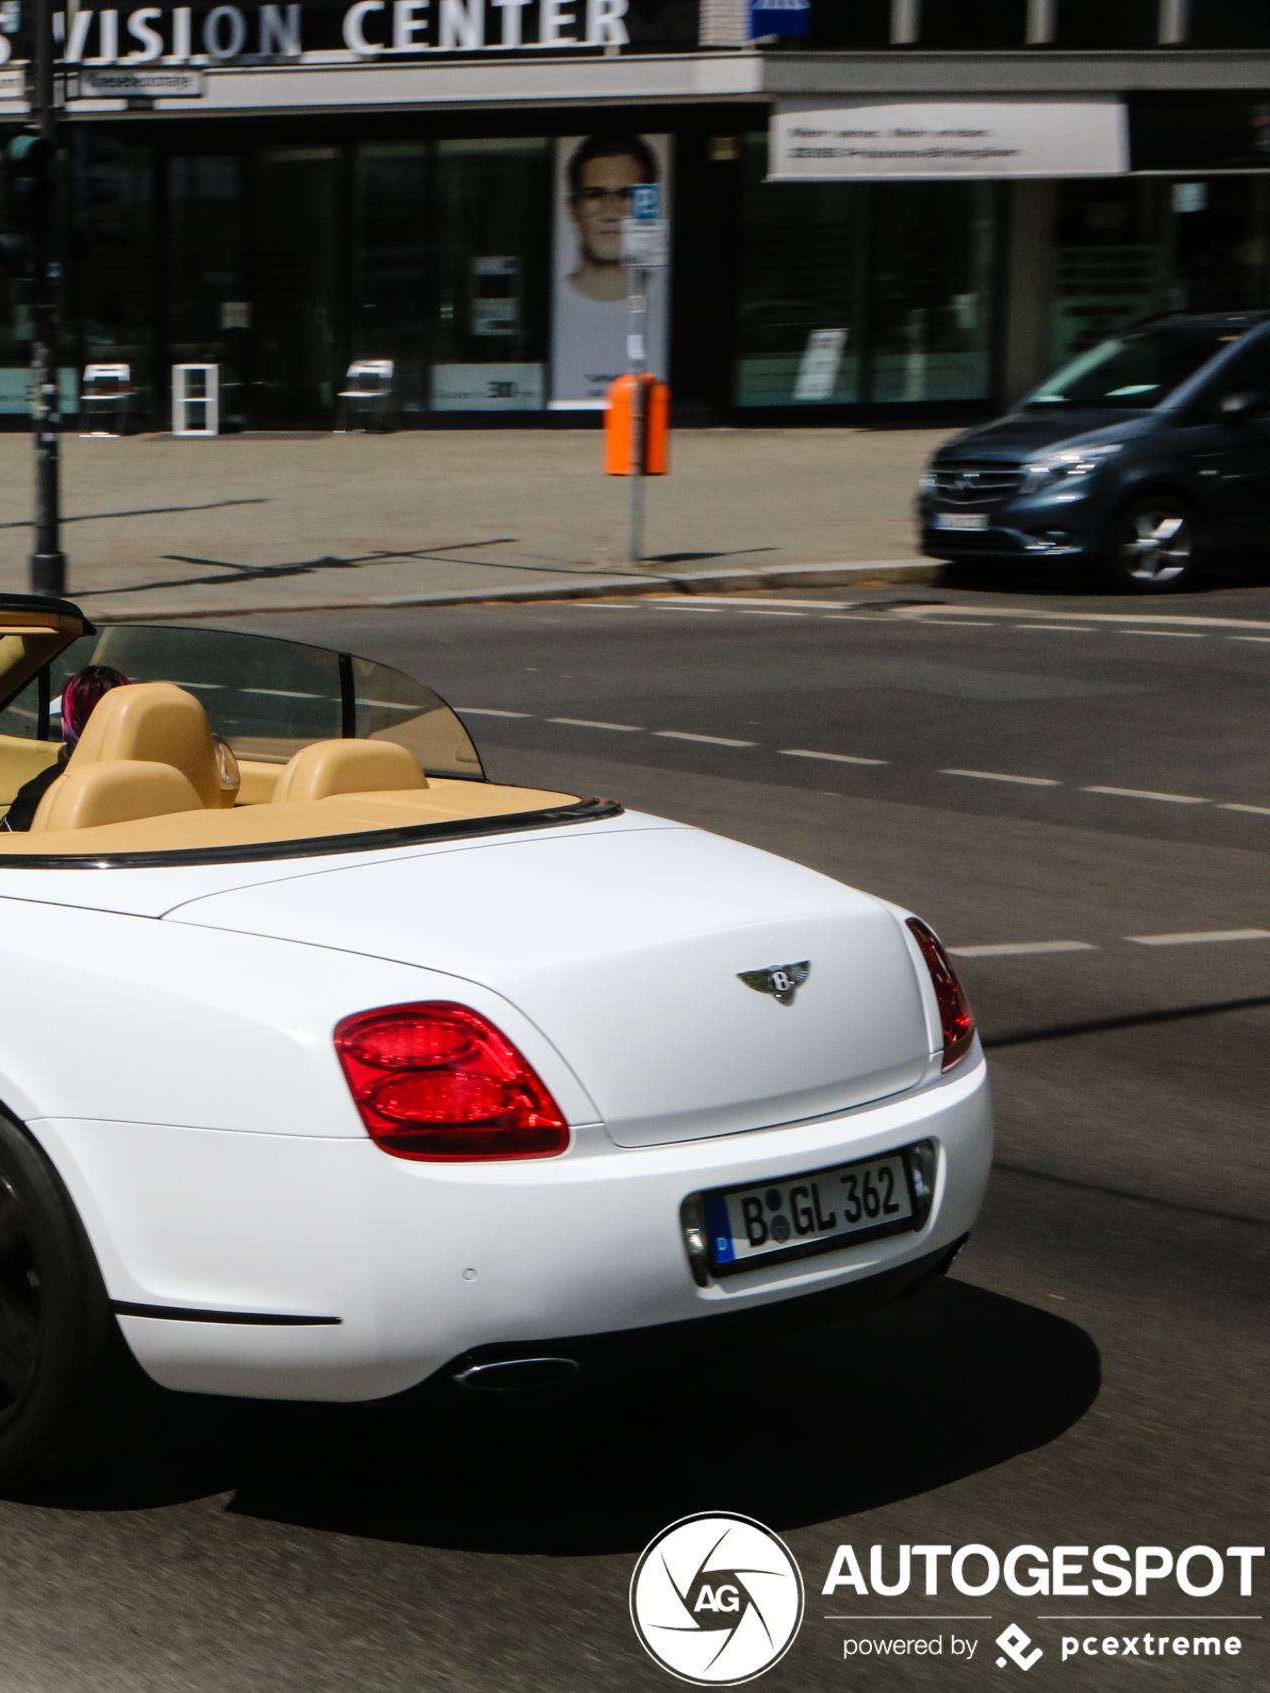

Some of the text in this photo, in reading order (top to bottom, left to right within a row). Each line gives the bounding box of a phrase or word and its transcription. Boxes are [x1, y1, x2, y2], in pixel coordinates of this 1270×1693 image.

[51, 4, 302, 63] VISION
[342, 0, 630, 54] CENTER
[741, 1166, 900, 1247] B GL 362
